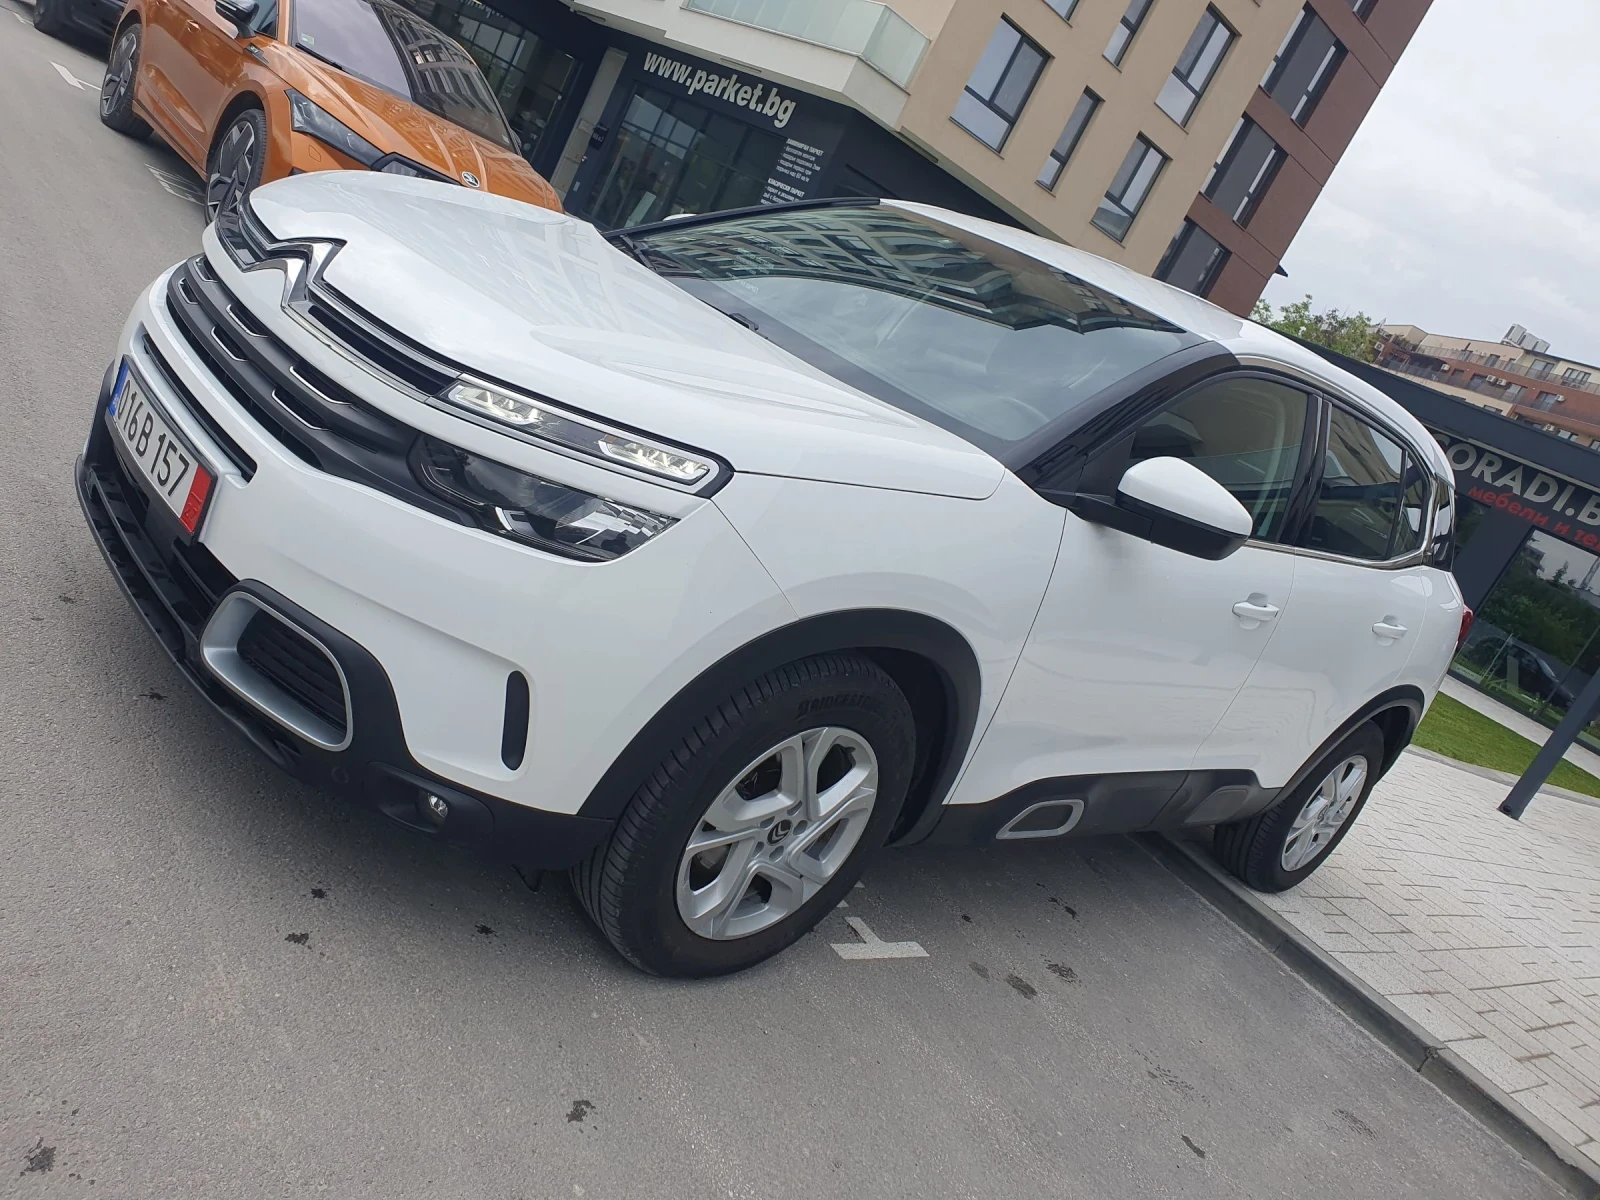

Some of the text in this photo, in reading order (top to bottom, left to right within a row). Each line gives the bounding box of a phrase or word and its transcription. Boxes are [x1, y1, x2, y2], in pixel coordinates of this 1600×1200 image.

[643, 52, 796, 129] www.parket.bg
[117, 380, 190, 497] 016B 157
[1467, 486, 1600, 552] мебели и те
